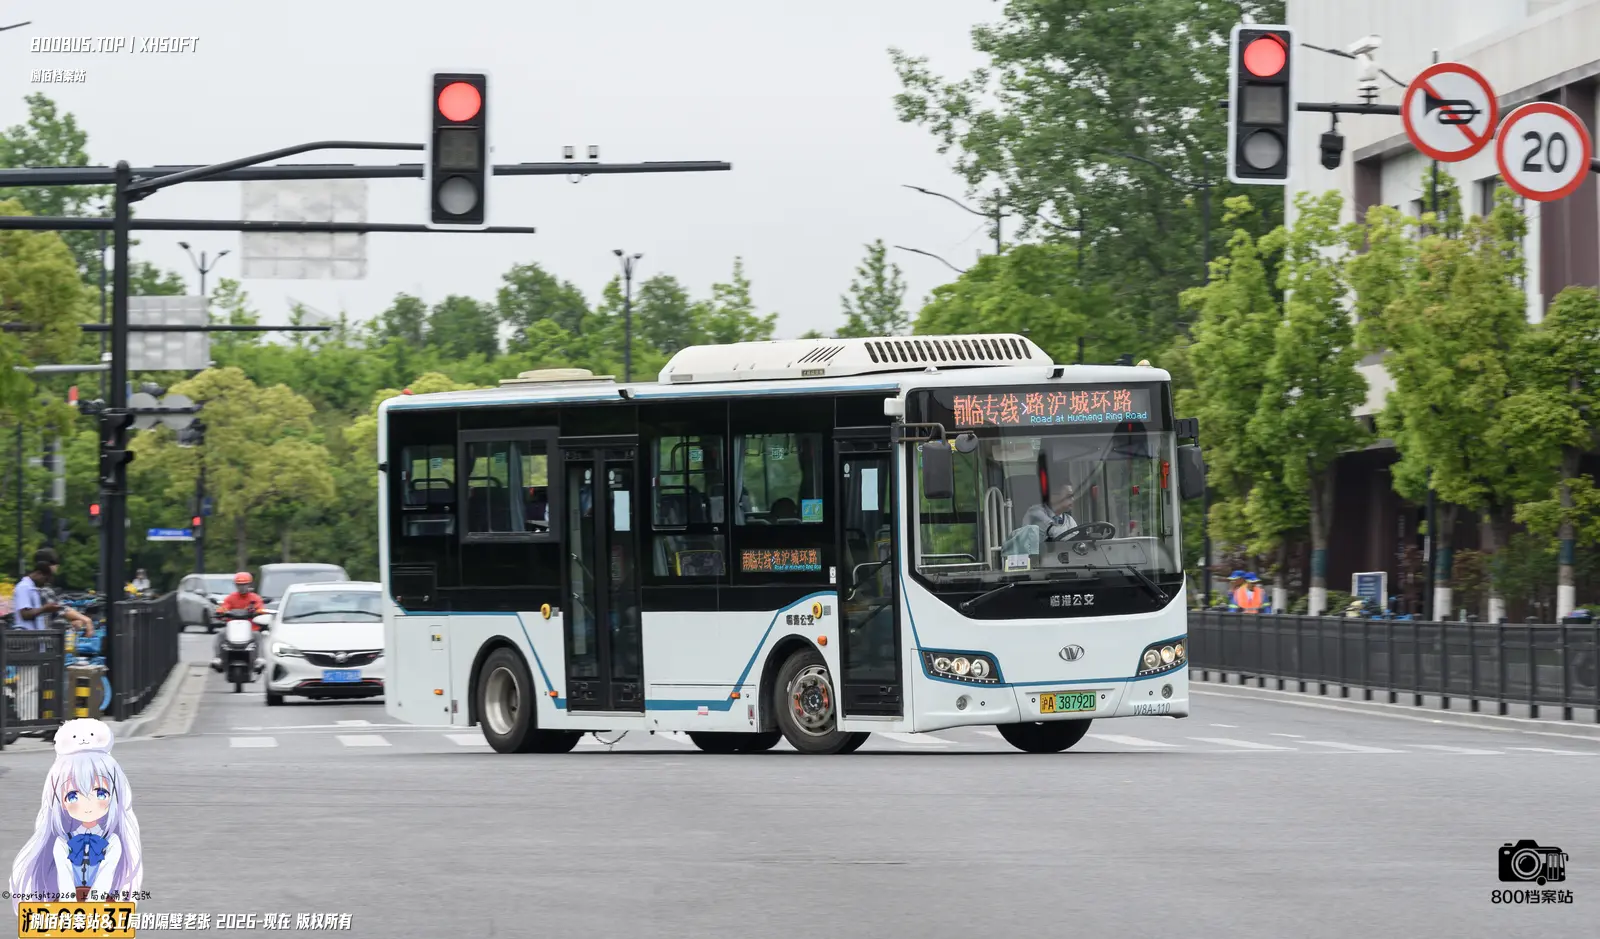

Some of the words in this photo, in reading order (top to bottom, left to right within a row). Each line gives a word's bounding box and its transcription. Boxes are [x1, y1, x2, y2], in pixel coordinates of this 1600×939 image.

[1521, 130, 1568, 174] 20
[1030, 415, 1053, 424] Road
[1055, 415, 1064, 423] at
[1105, 412, 1123, 422] Ring
[1049, 593, 1095, 607] 临港公交
[1058, 693, 1095, 710] 38792D
[1133, 702, 1171, 715] W8A-110
